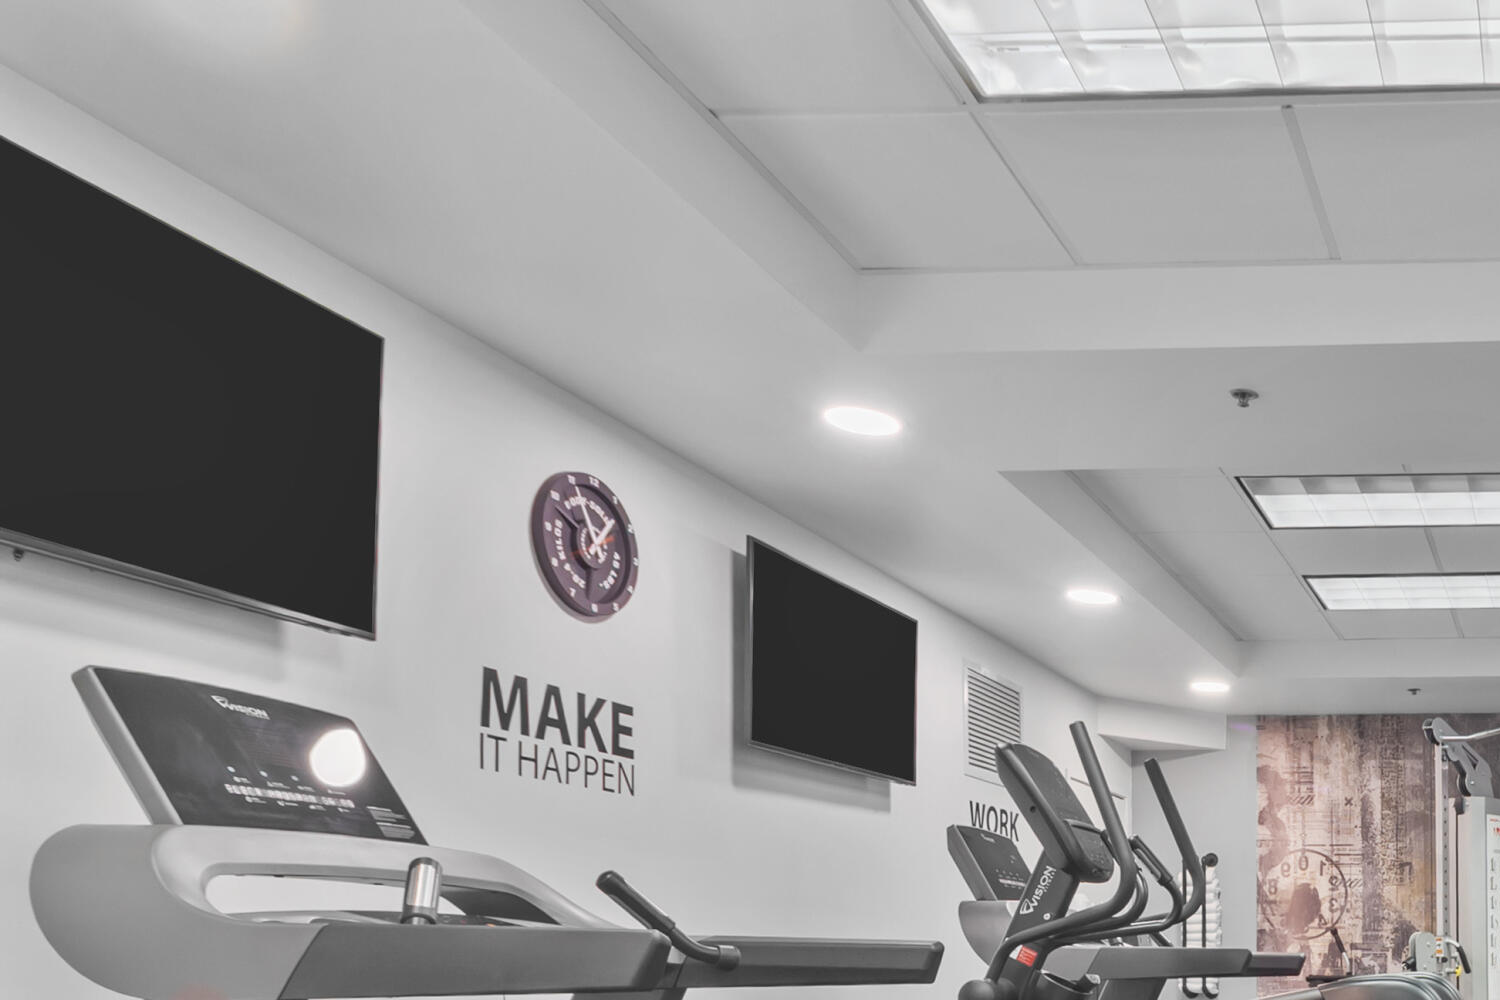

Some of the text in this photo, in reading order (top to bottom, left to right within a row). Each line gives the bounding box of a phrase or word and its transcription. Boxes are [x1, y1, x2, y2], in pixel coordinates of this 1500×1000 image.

[588, 476, 600, 488] 12
[480, 666, 635, 760] MAKE
[479, 732, 635, 797] IT HAPPEN
[969, 800, 1020, 842] WORK
[1030, 865, 1056, 907] VISION
